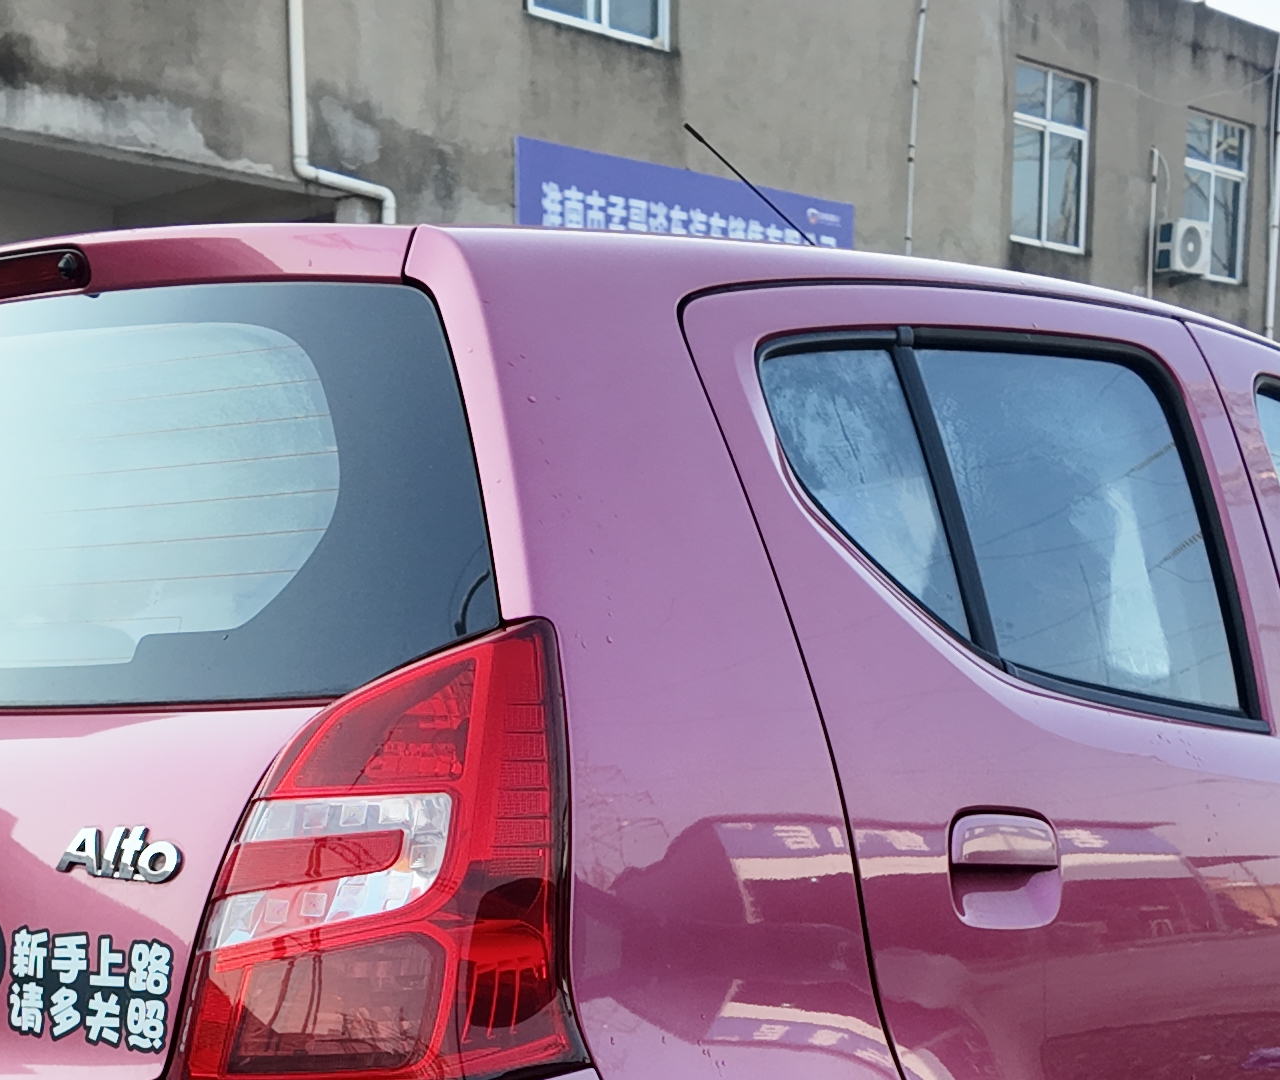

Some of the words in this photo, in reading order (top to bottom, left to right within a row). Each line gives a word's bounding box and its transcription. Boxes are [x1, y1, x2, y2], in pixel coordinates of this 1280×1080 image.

[56, 825, 182, 884] Alto
[11, 927, 172, 996] 新手上路
[9, 980, 167, 1050] 请多关照
